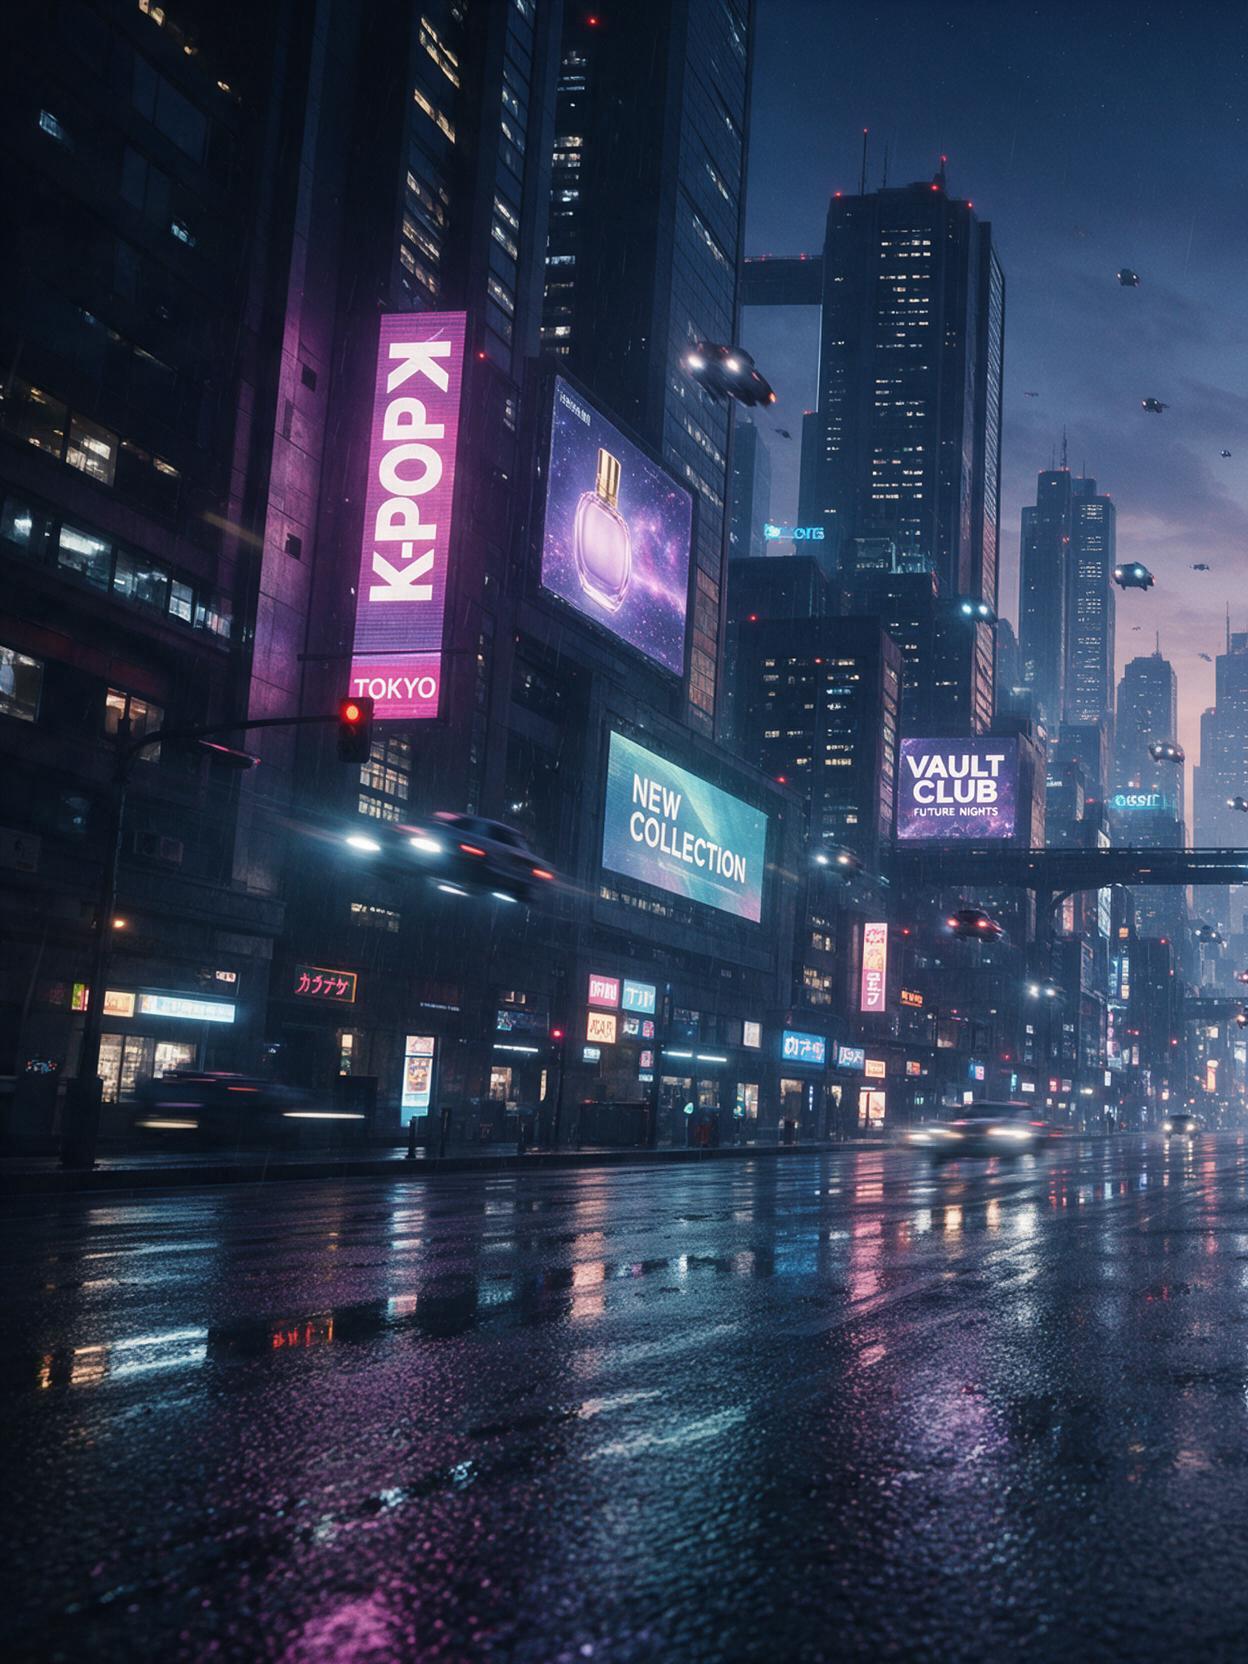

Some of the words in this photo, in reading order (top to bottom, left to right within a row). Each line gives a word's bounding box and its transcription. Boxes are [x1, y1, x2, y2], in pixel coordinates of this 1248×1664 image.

[353, 676, 437, 700] TOKYO
[905, 754, 1005, 778] VAULT
[632, 773, 682, 821] NEW
[912, 779, 998, 804] CLUB
[913, 806, 956, 817] FUTURE
[959, 806, 999, 817] NIGHTS
[629, 811, 747, 884] COLLECTION
